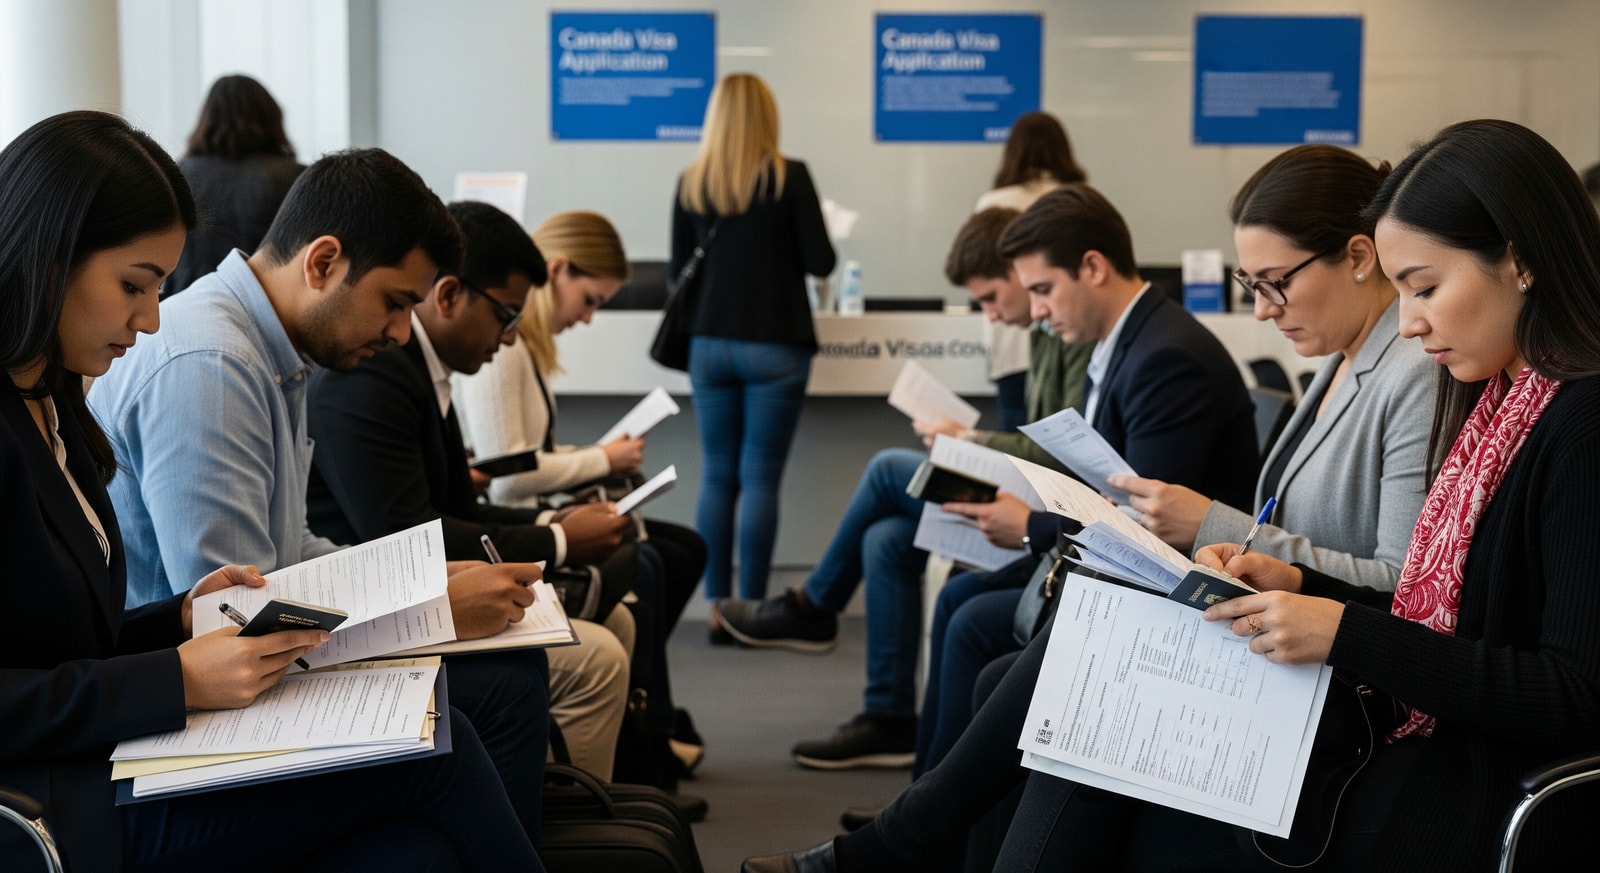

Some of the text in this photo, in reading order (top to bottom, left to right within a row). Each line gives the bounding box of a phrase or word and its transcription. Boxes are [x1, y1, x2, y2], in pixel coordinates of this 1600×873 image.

[559, 27, 678, 50] Canada Visa
[881, 28, 1000, 51] Canada Visa
[559, 51, 668, 74] Application
[882, 51, 986, 74] Application
